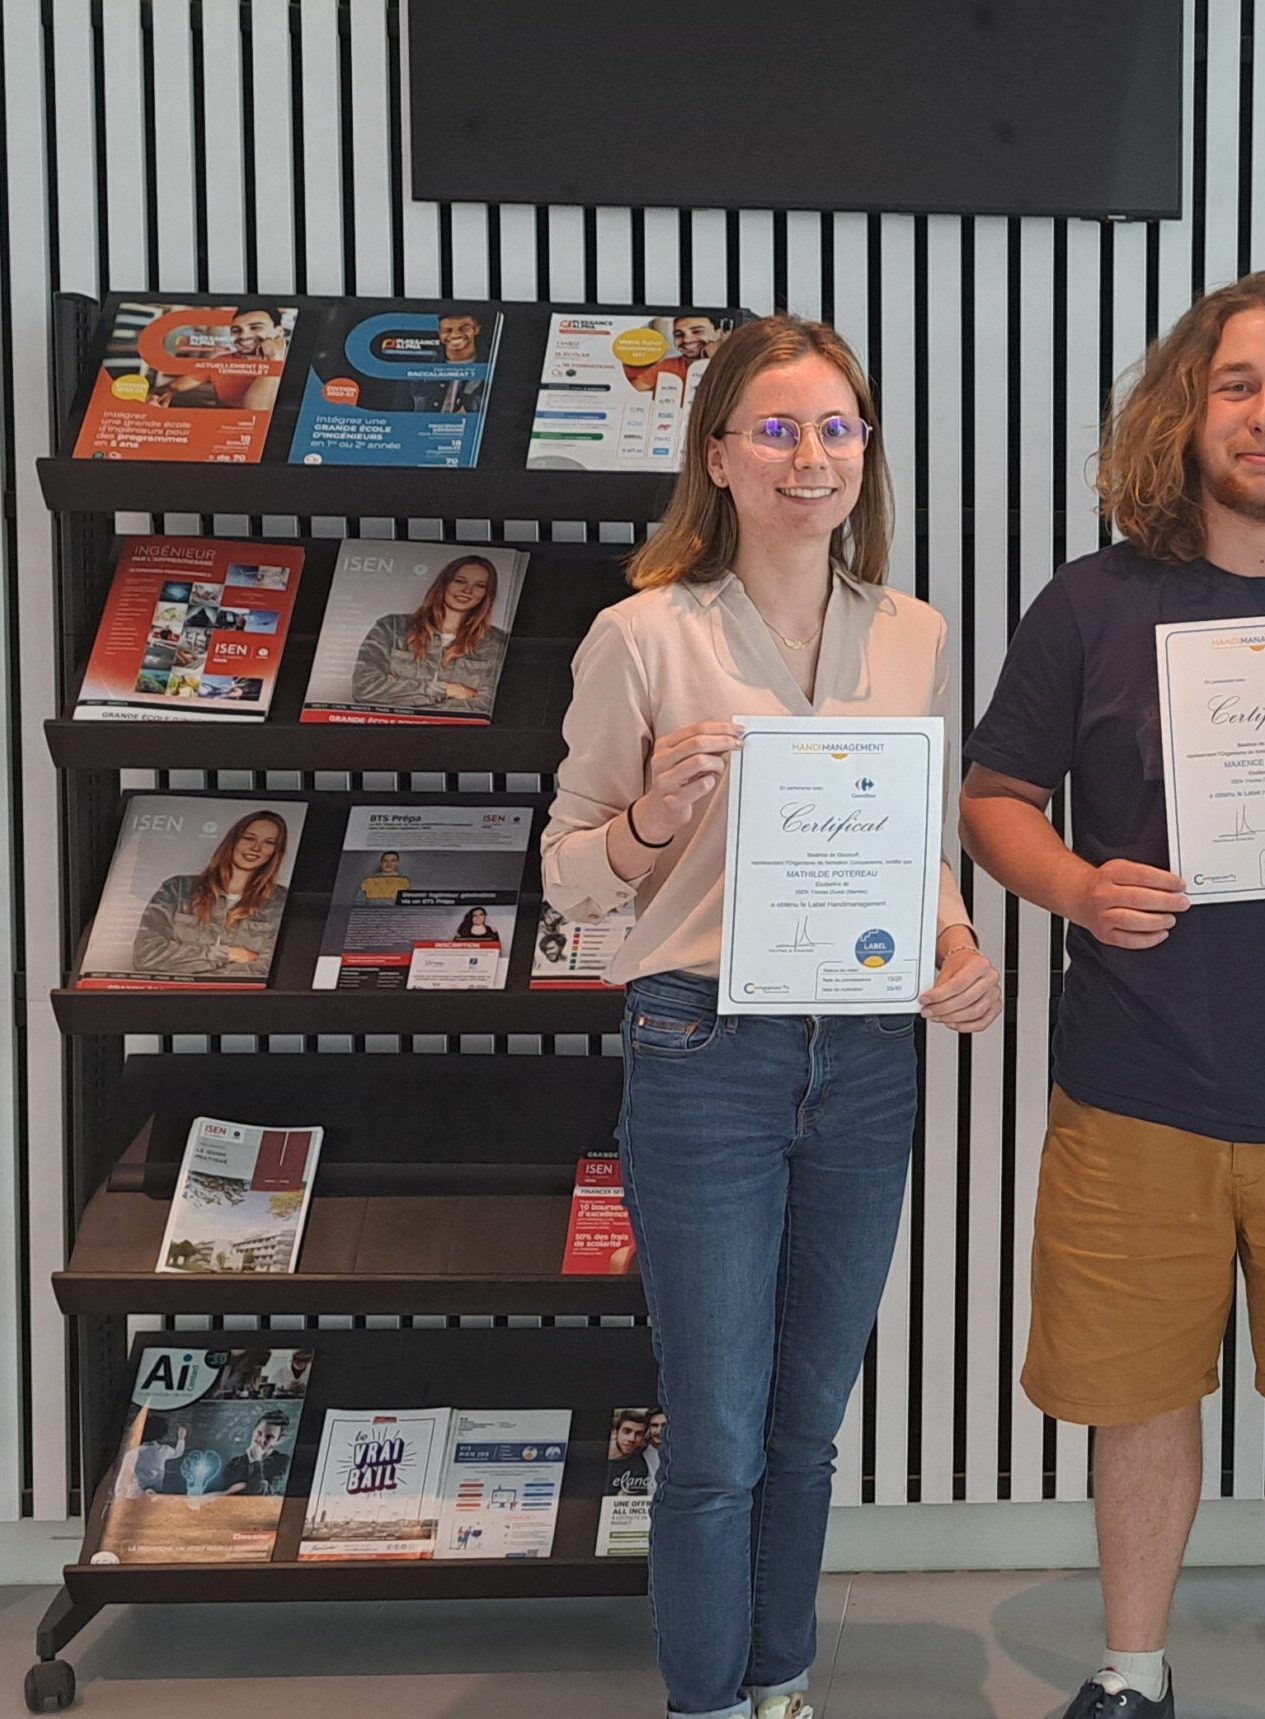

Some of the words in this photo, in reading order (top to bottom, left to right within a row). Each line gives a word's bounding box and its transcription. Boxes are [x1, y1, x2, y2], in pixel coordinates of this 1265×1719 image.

[316, 415, 363, 425] Intégrez
[314, 424, 357, 432] GRANDE
[359, 425, 392, 433] ÉCOLE
[312, 431, 384, 440] D'INGÉNIEURS
[367, 441, 401, 449] année
[133, 545, 216, 560] INGÉNIEUR
[343, 555, 394, 573] ISEN
[215, 643, 247, 655] ISEN
[328, 714, 365, 724] GRANDE
[792, 743, 885, 752] HANDIMANAGEMENT
[1224, 758, 1264, 768] MAXENCE
[132, 814, 185, 831] ISEN
[370, 814, 389, 822] BTS
[391, 814, 421, 823] Prépa
[483, 814, 505, 822] ISEN
[779, 802, 890, 842] Certificat
[786, 870, 830, 878] MATHILDE
[832, 869, 878, 878] POTEREAU
[863, 942, 887, 950] LABEL
[205, 1124, 227, 1136] ISEN
[585, 1163, 613, 1174] ISEN
[140, 1353, 193, 1391] Ai
[353, 1437, 405, 1470] VRAI
